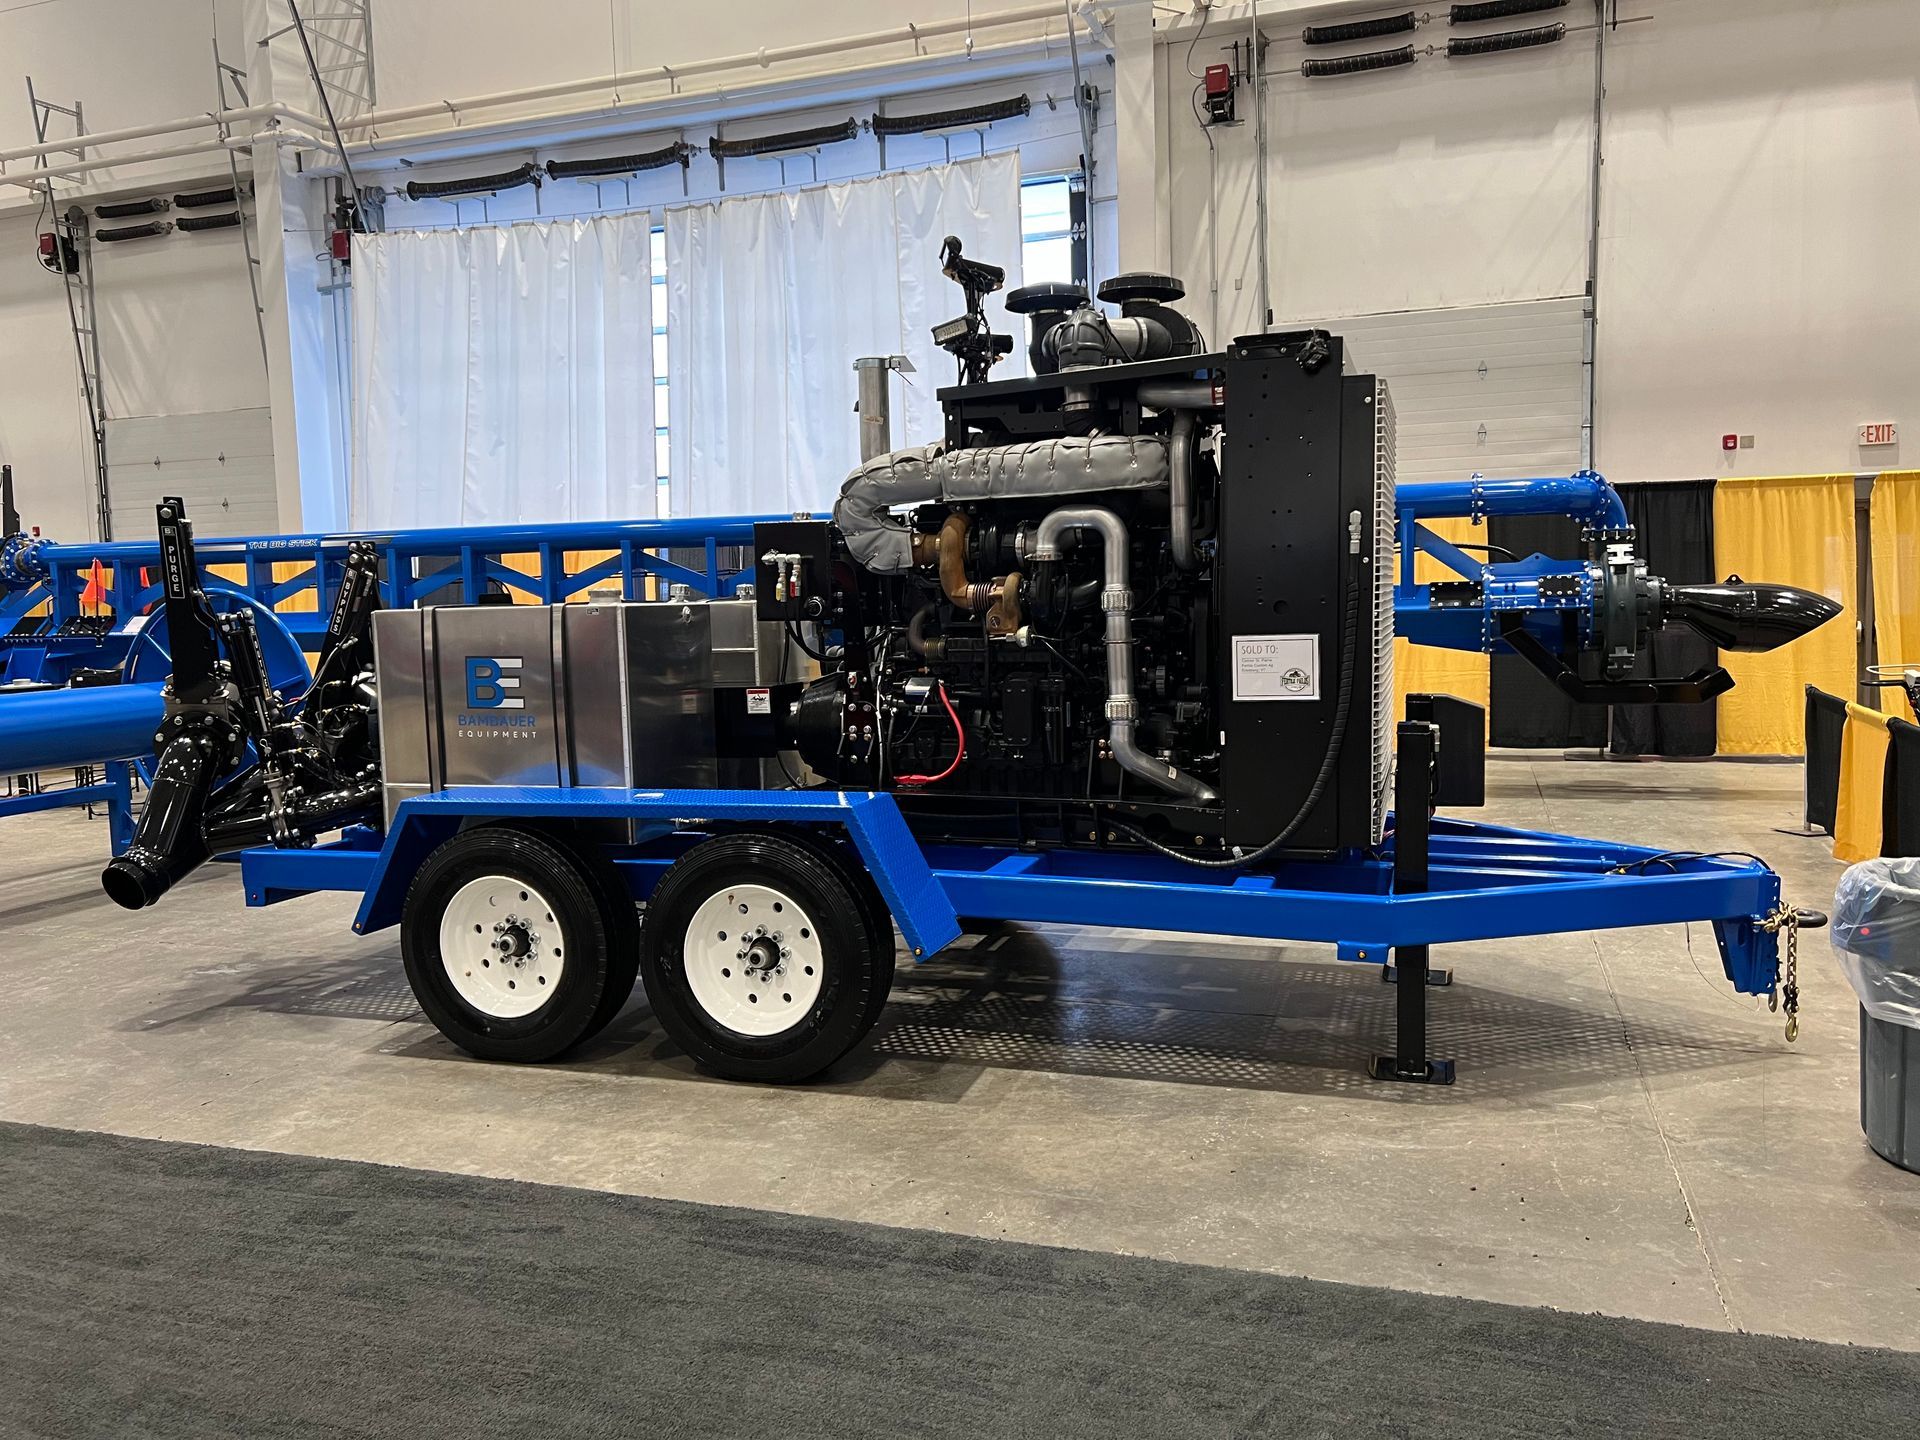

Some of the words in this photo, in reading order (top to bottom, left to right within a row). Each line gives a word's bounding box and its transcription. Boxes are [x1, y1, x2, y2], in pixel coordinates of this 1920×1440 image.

[1866, 424, 1892, 443] EXIT
[249, 541, 267, 549] THE
[269, 540, 287, 548] BIG
[288, 538, 318, 547] STICK
[168, 545, 180, 592] PURGE
[333, 582, 351, 632] BYPASS
[1241, 645, 1263, 655] SOLD
[1265, 644, 1279, 654] TO:
[465, 656, 525, 709] BE
[458, 714, 536, 727] BAMBAUER
[458, 730, 537, 739] EQUIPMENT
